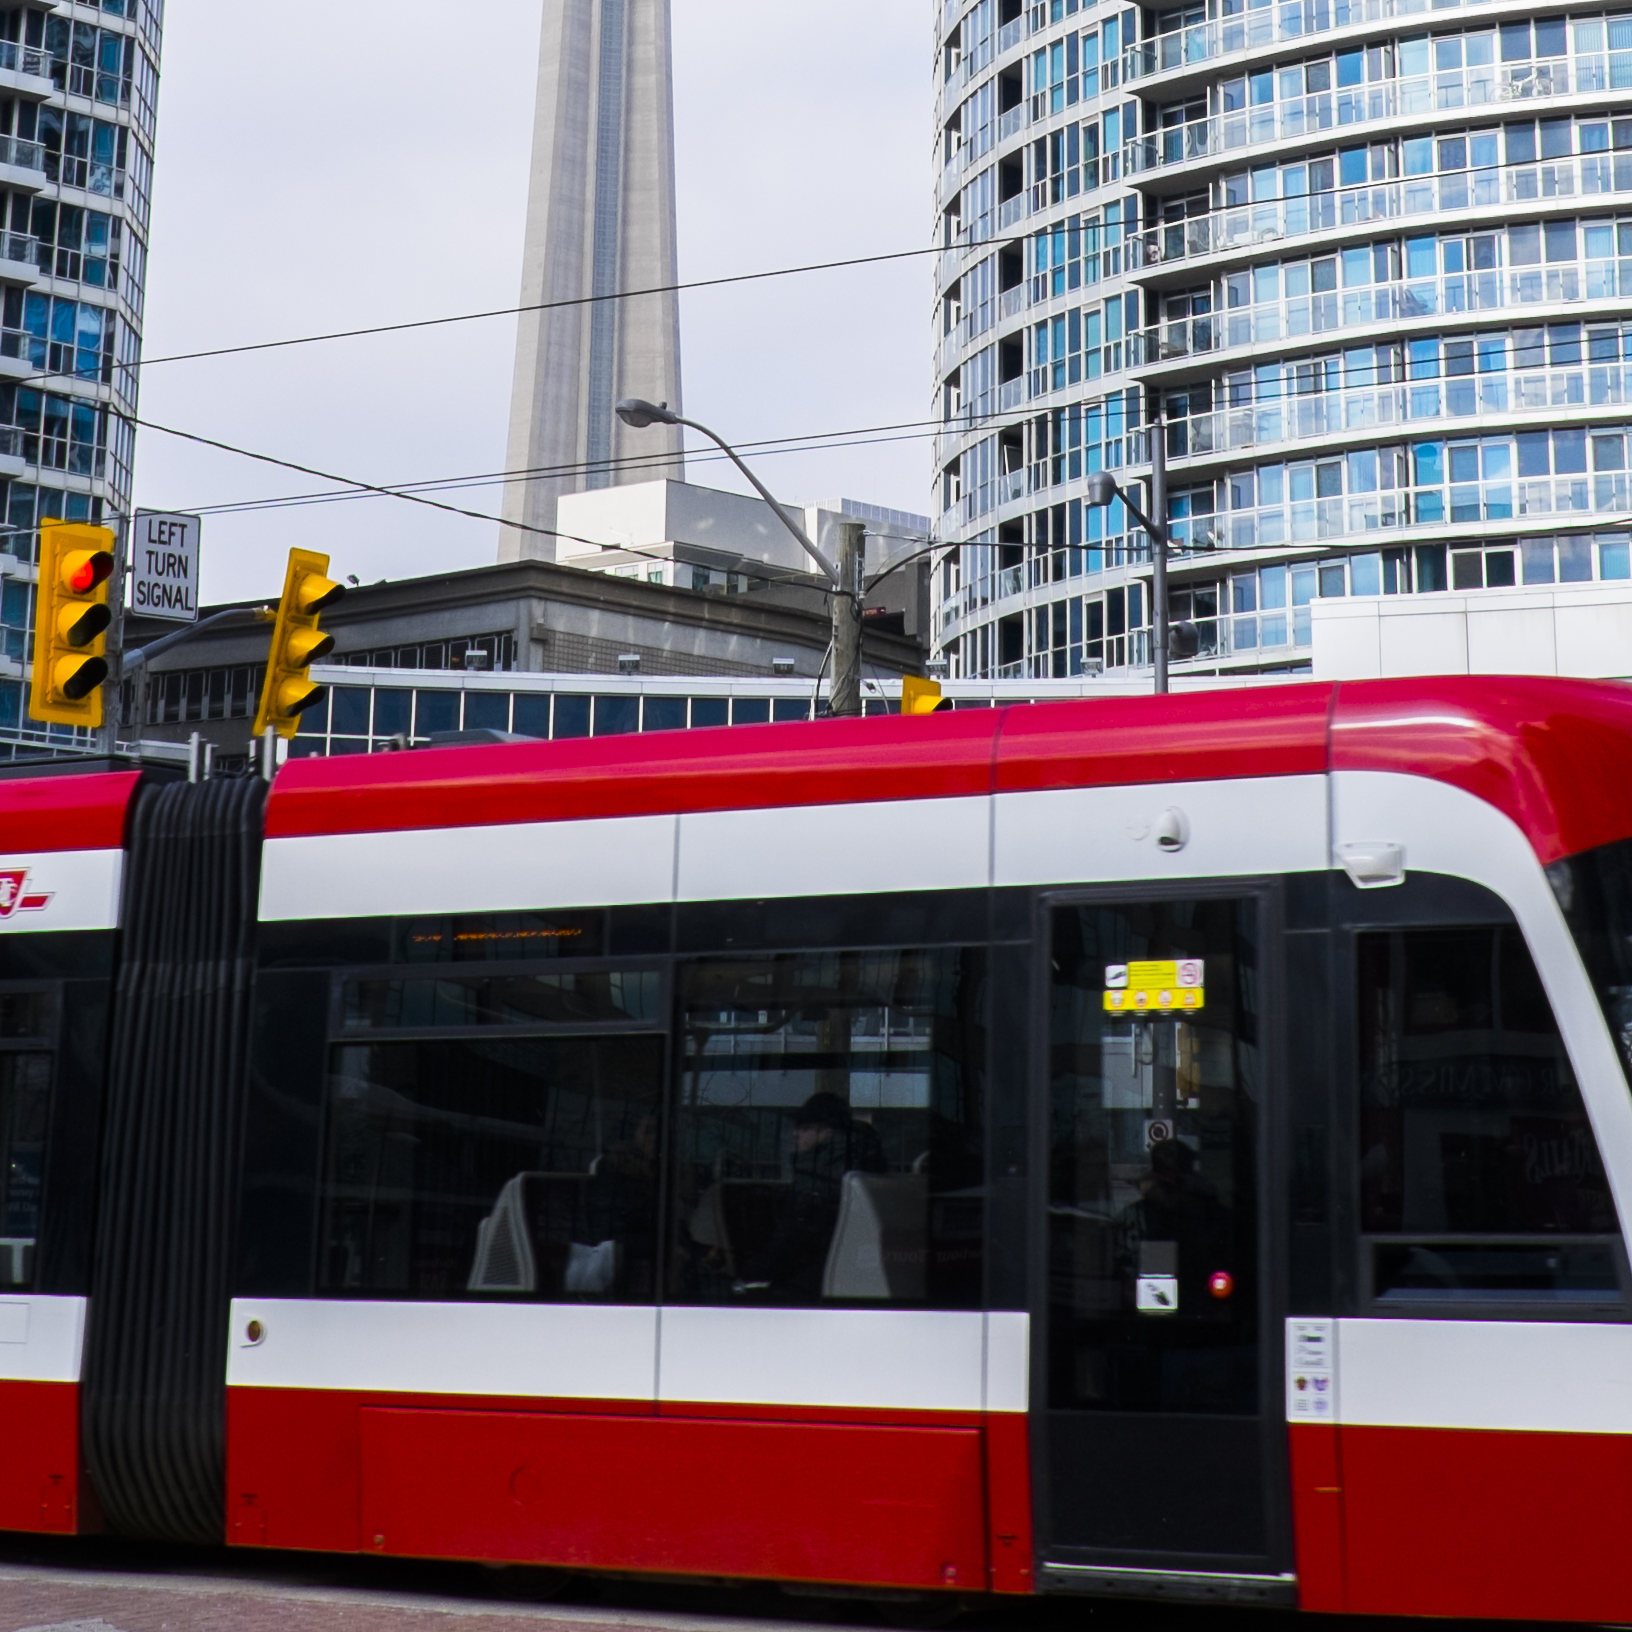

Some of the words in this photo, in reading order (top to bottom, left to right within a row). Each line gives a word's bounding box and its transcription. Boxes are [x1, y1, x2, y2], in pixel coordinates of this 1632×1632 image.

[147, 517, 188, 547] LEFT
[145, 549, 189, 580] TURN
[136, 580, 194, 613] SIGNAL
